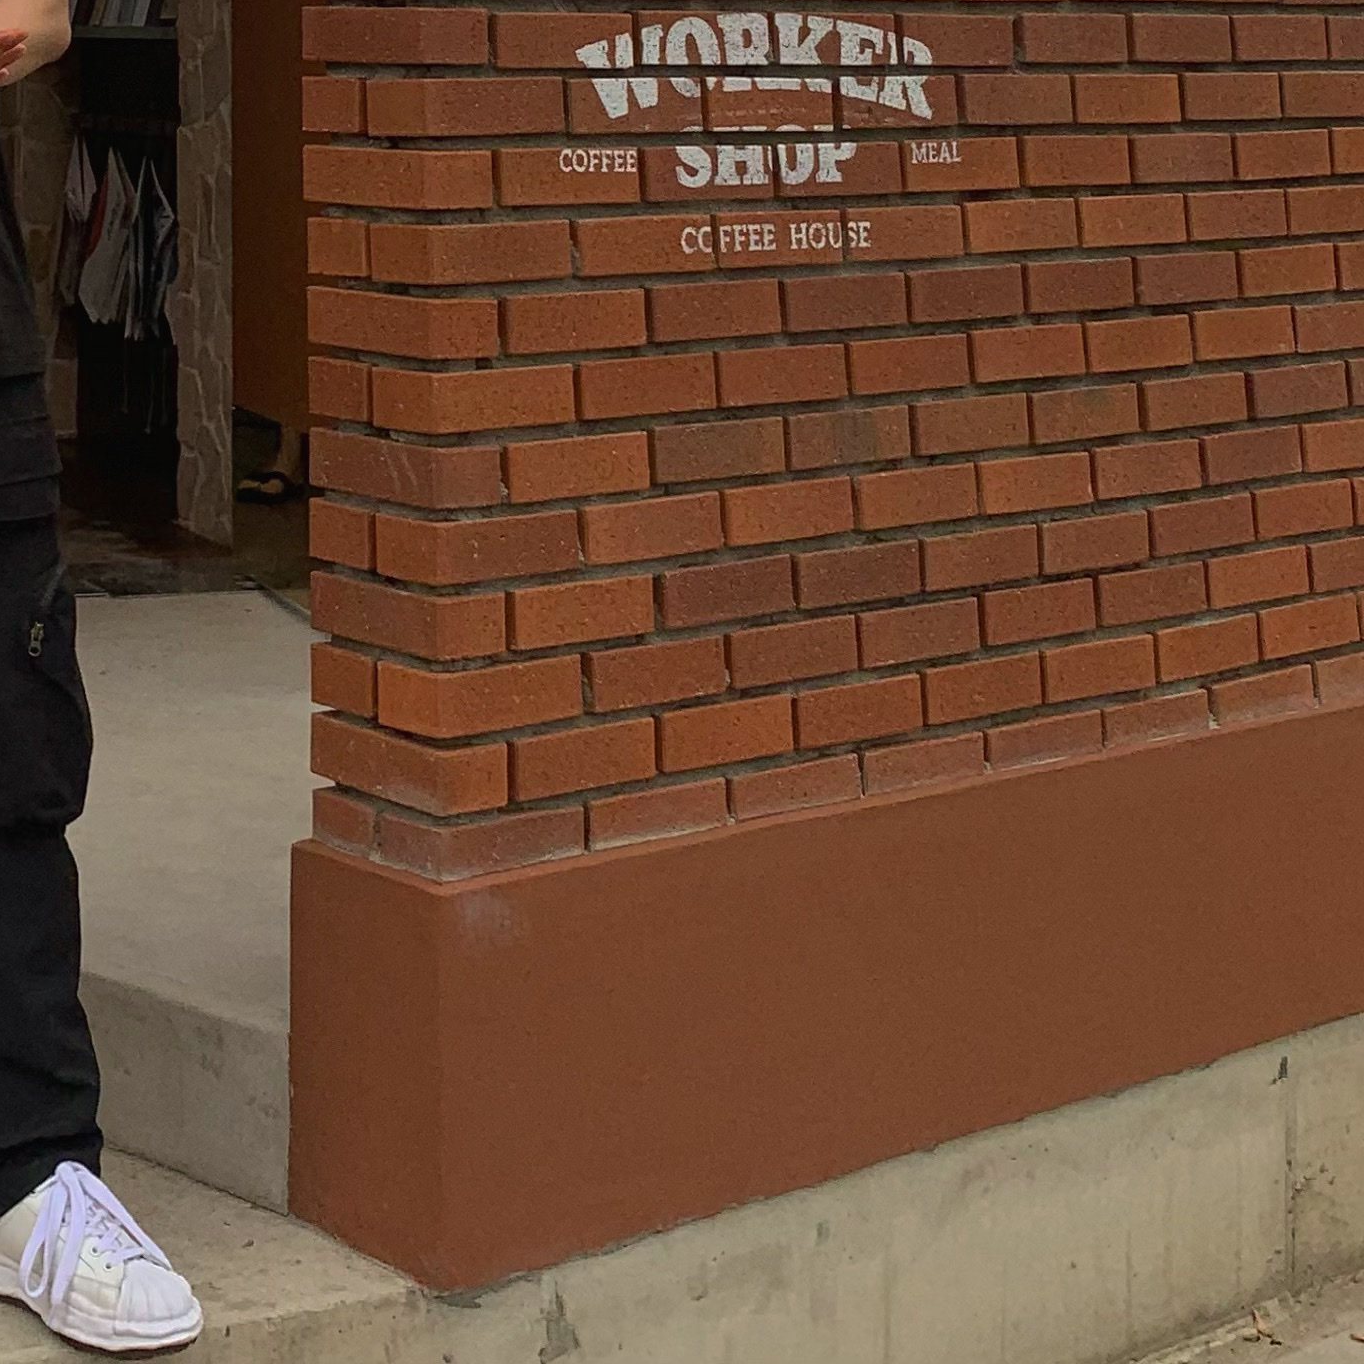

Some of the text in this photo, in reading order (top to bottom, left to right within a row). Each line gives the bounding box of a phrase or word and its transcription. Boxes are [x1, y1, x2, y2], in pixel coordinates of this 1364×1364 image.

[574, 12, 933, 120] WORKER
[559, 147, 637, 173] COFFEE
[675, 124, 858, 188] SHOP
[911, 141, 962, 164] MEAL
[680, 221, 872, 254] COFFEE HOUSE
